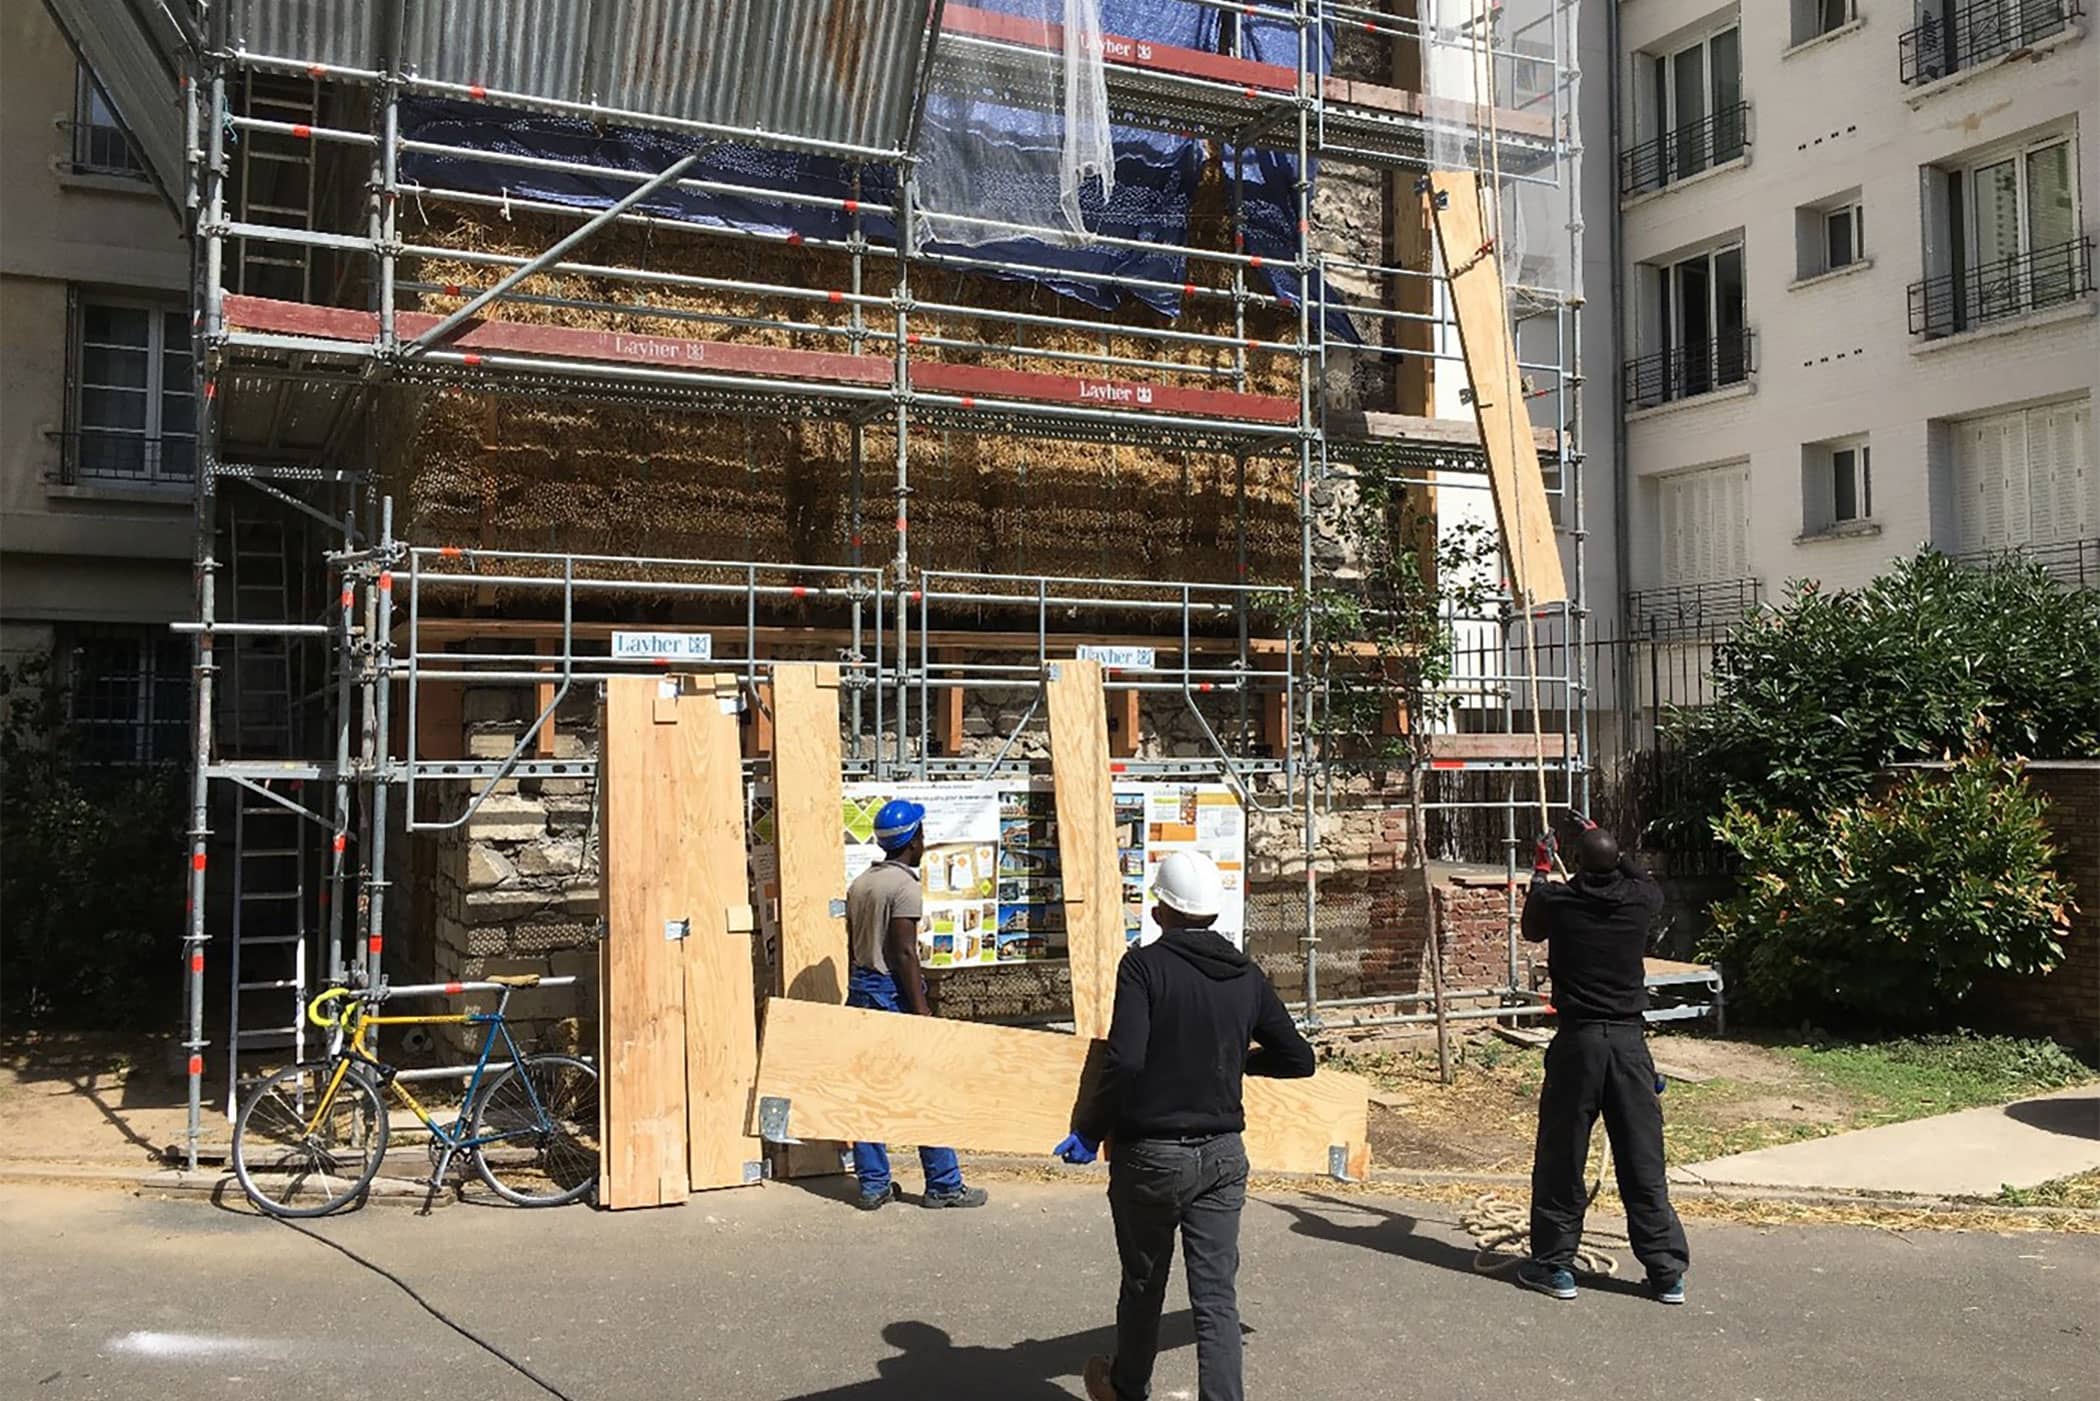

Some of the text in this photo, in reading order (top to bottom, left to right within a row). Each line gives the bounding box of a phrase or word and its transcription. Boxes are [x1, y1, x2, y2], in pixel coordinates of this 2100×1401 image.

[1080, 34, 1131, 57] Lyher
[615, 337, 680, 360] Layher
[1080, 381, 1132, 402] Layher
[617, 635, 681, 654] Layher
